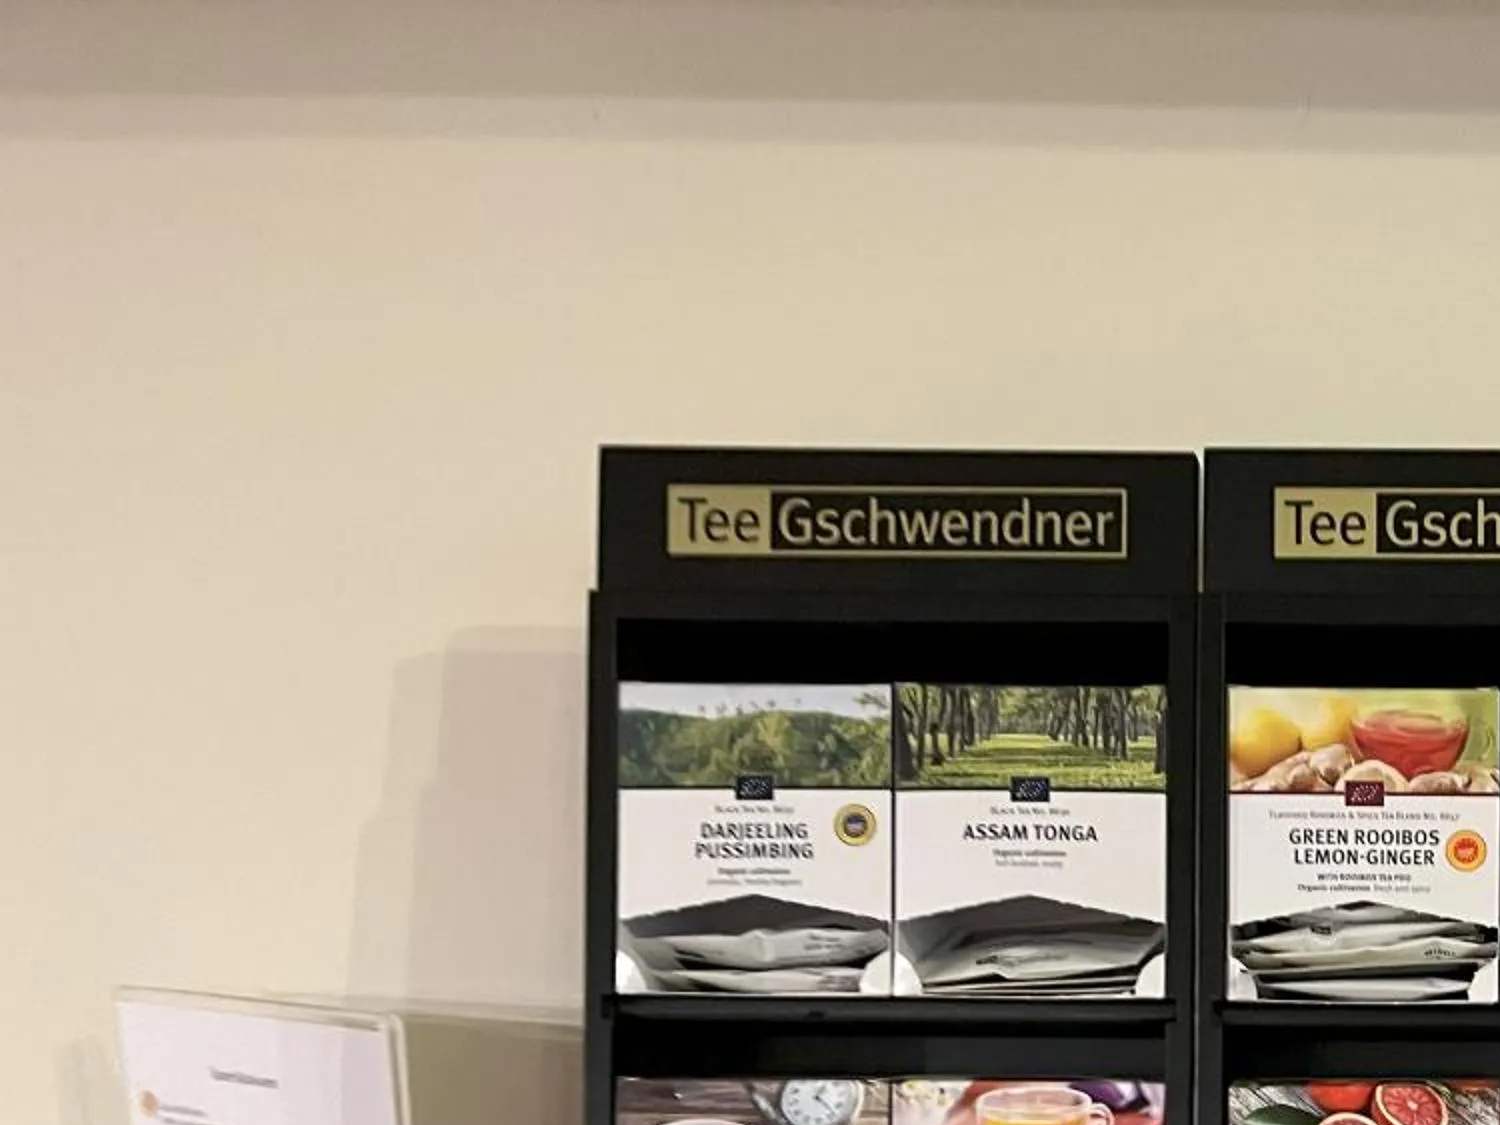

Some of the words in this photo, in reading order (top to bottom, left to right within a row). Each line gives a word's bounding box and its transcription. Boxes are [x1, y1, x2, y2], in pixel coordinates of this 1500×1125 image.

[677, 496, 759, 544] Tee
[778, 496, 1114, 547] Gschwendner
[1284, 499, 1367, 546] Tee
[700, 822, 809, 840] DARJEELING
[963, 824, 1029, 841] ASSAM
[1034, 824, 1098, 841] TONGA
[1289, 828, 1349, 845] GREEN
[1354, 828, 1440, 845] ROOIBOS
[694, 842, 814, 859] PUSSIMBING
[1294, 848, 1435, 866] LEMON-GINGER
